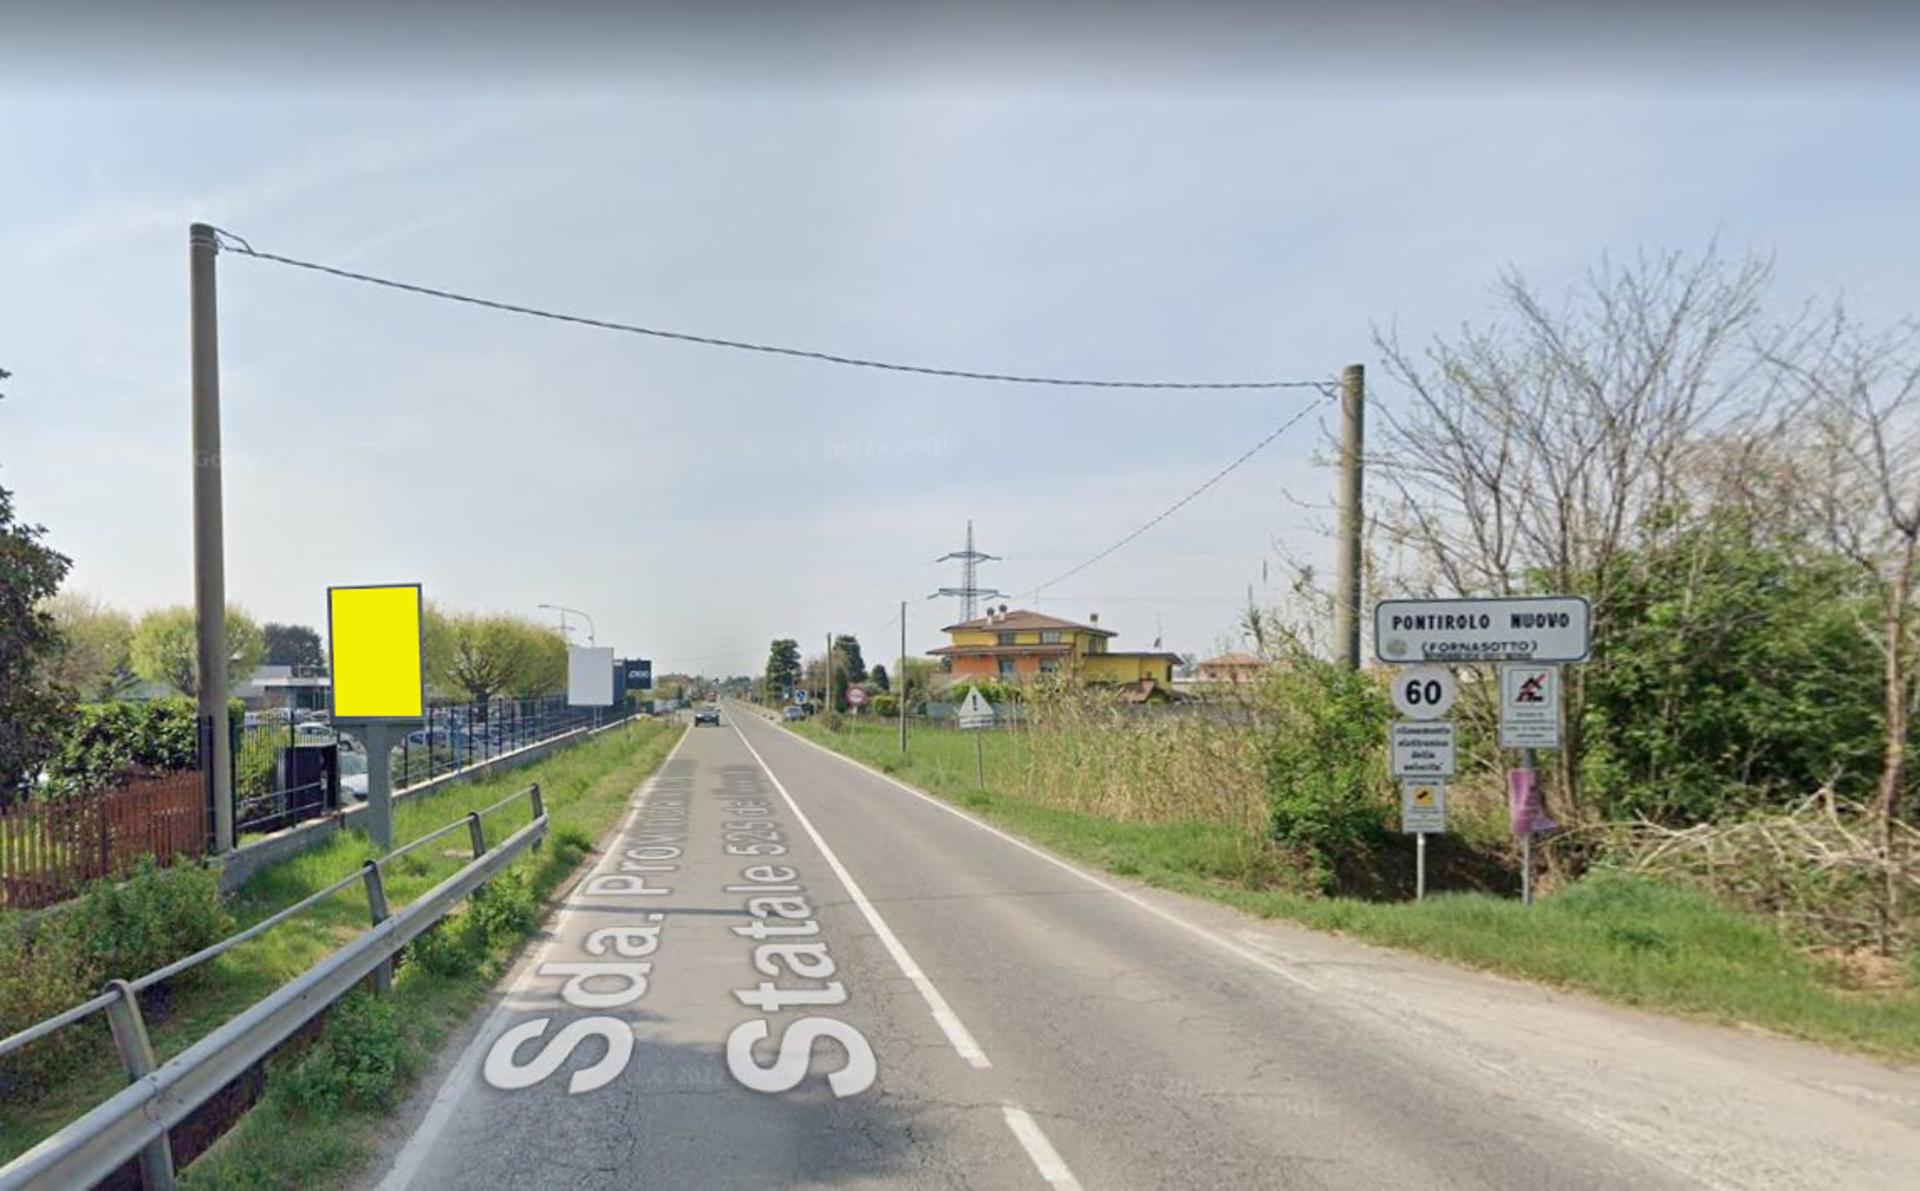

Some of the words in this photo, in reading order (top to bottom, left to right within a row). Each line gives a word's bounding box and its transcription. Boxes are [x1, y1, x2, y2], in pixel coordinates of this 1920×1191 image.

[1392, 613, 1490, 630] PONTIROLO
[1510, 612, 1570, 629] NUOVO
[1421, 640, 1538, 655] (FORNASOTTO)
[1405, 679, 1442, 705] 60
